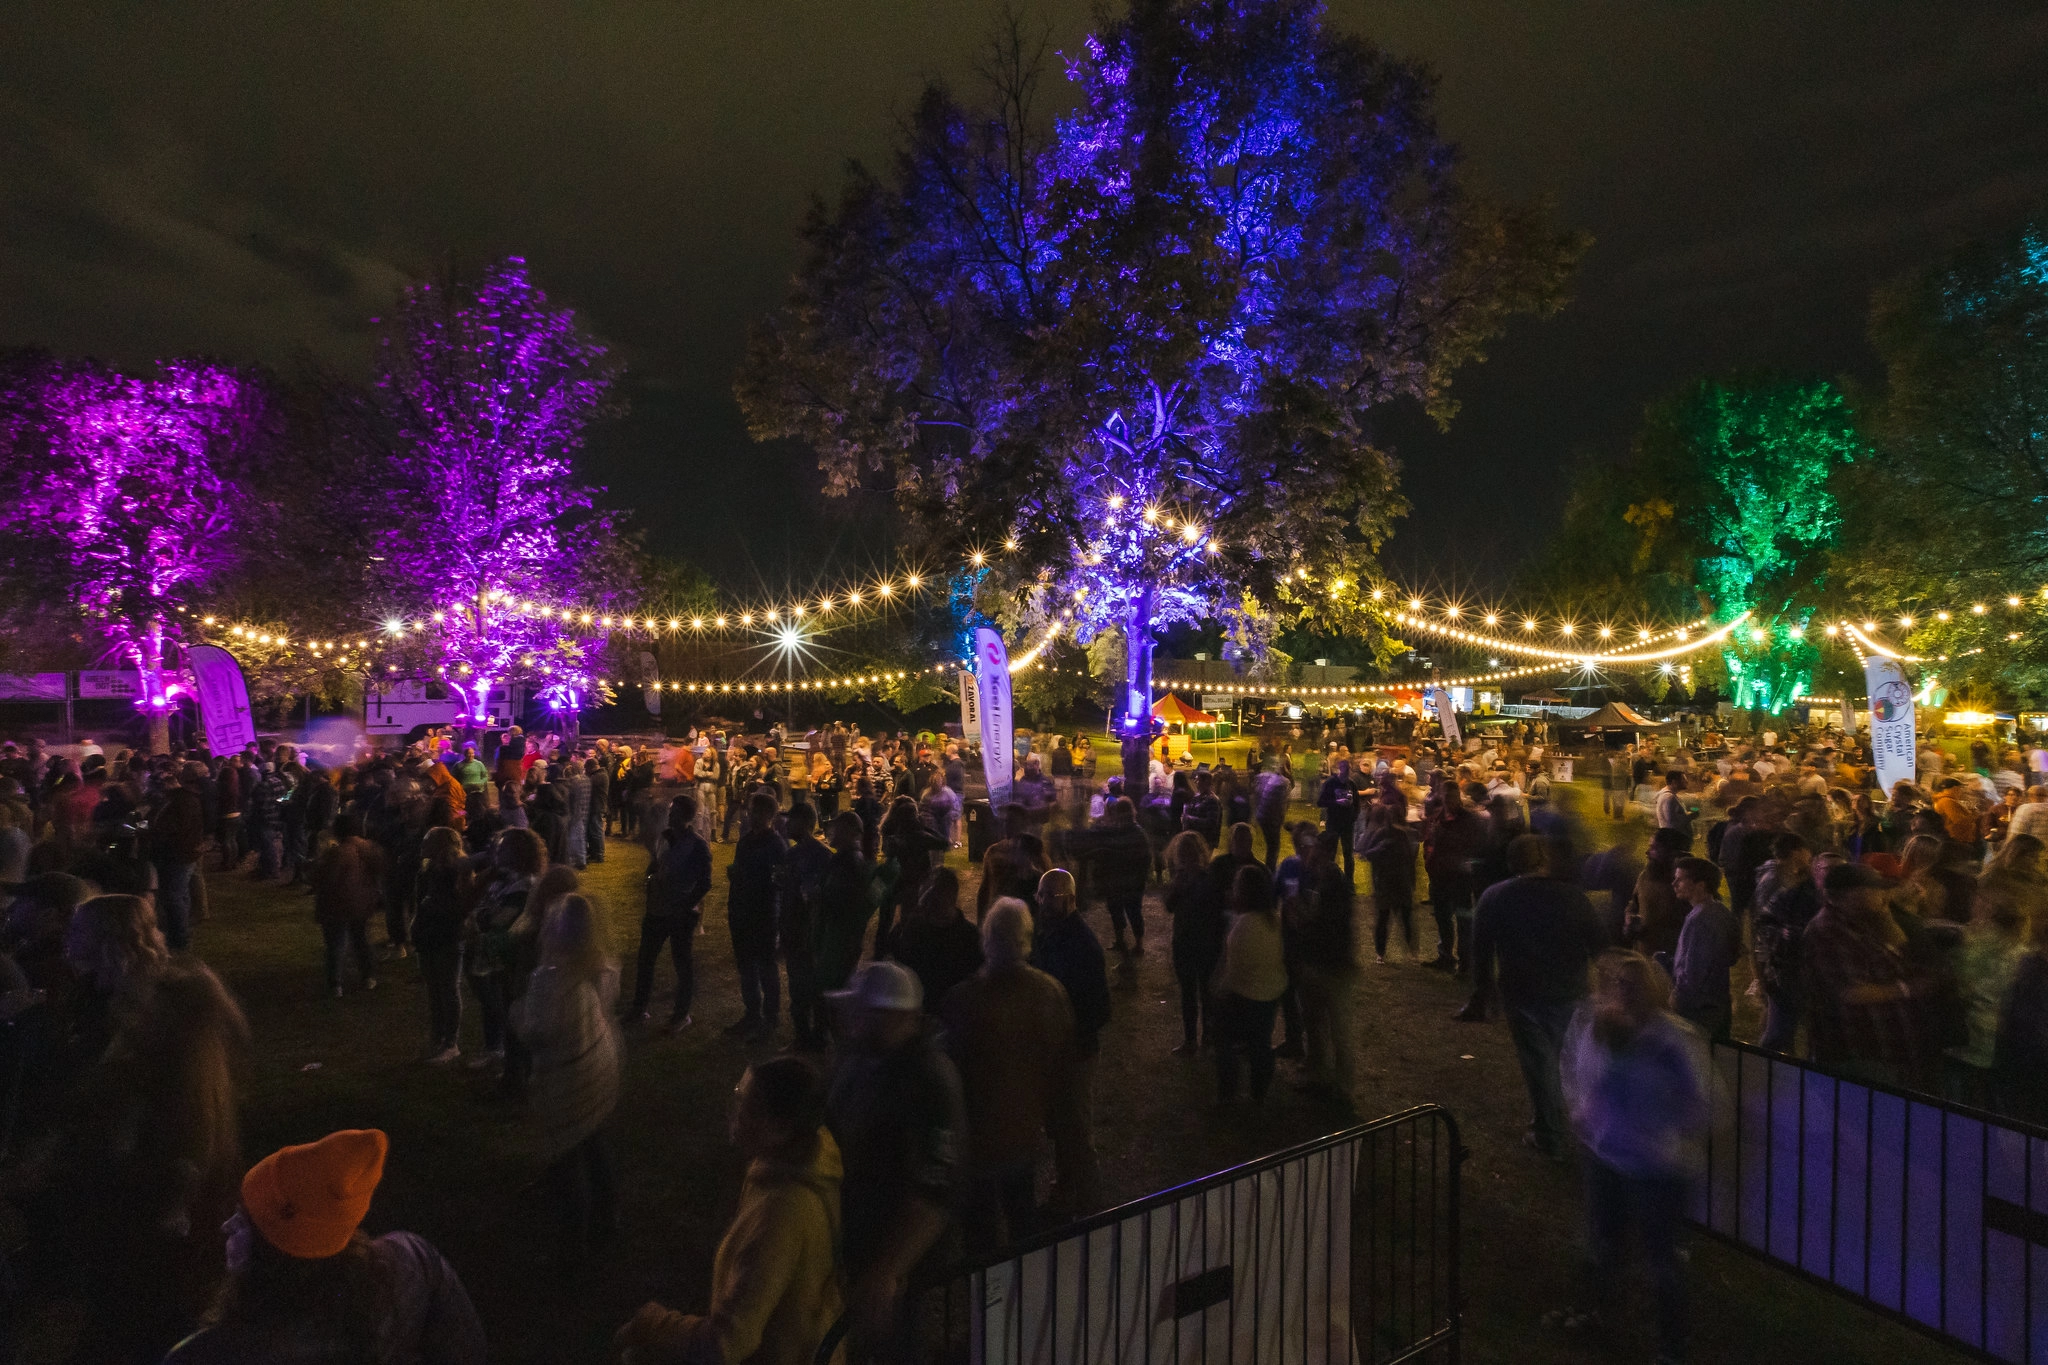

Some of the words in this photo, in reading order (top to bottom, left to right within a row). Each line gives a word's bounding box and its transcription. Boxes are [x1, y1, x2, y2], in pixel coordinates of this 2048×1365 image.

[967, 685, 976, 724] ZAVORAL
[1875, 726, 1885, 770] Company
[1884, 725, 1894, 753] Sugar
[1893, 724, 1905, 757] Crystal
[1904, 723, 1914, 768] American
